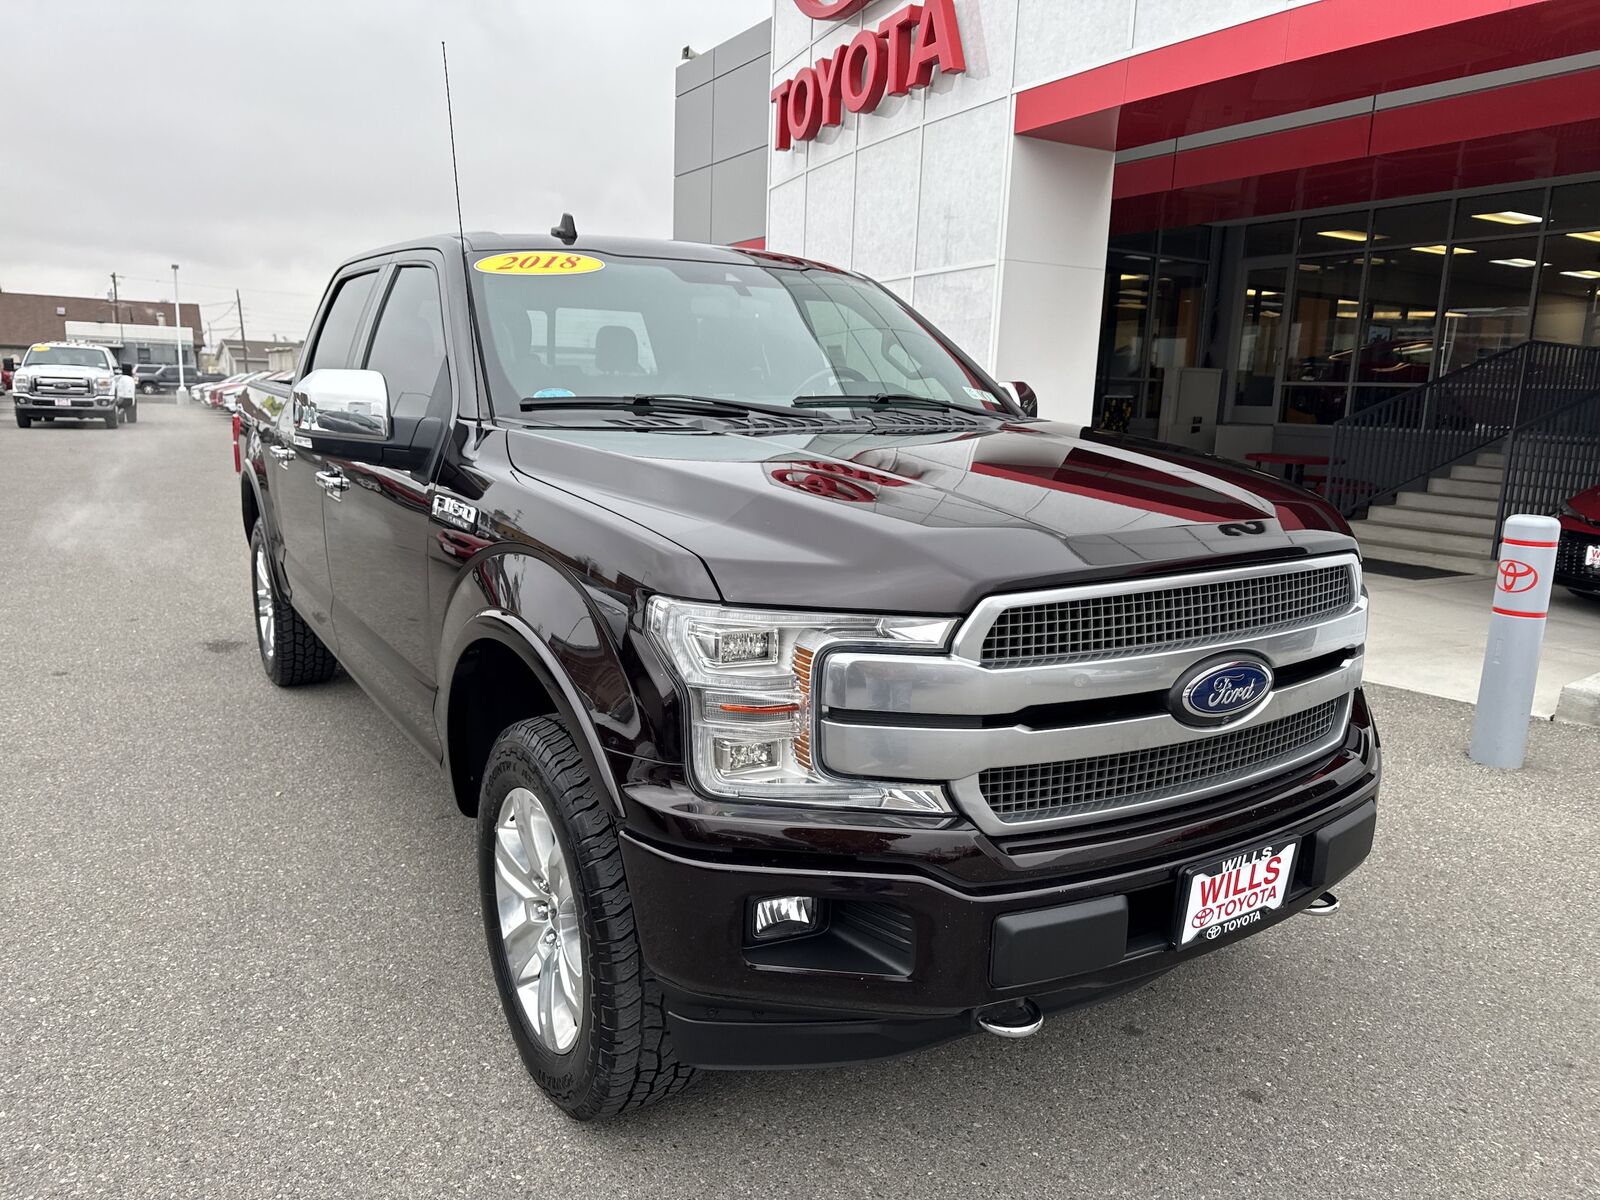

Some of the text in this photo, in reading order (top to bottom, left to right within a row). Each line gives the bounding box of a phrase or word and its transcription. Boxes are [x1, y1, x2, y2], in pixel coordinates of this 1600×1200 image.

[771, 0, 966, 151] TOYOTA
[496, 256, 581, 270] 2018
[1208, 674, 1256, 707] Ford
[1221, 847, 1272, 874] WILLS
[1201, 856, 1281, 907] WILLS
[1215, 885, 1277, 920] TOYOTA
[1223, 910, 1261, 933] TOYOTA
